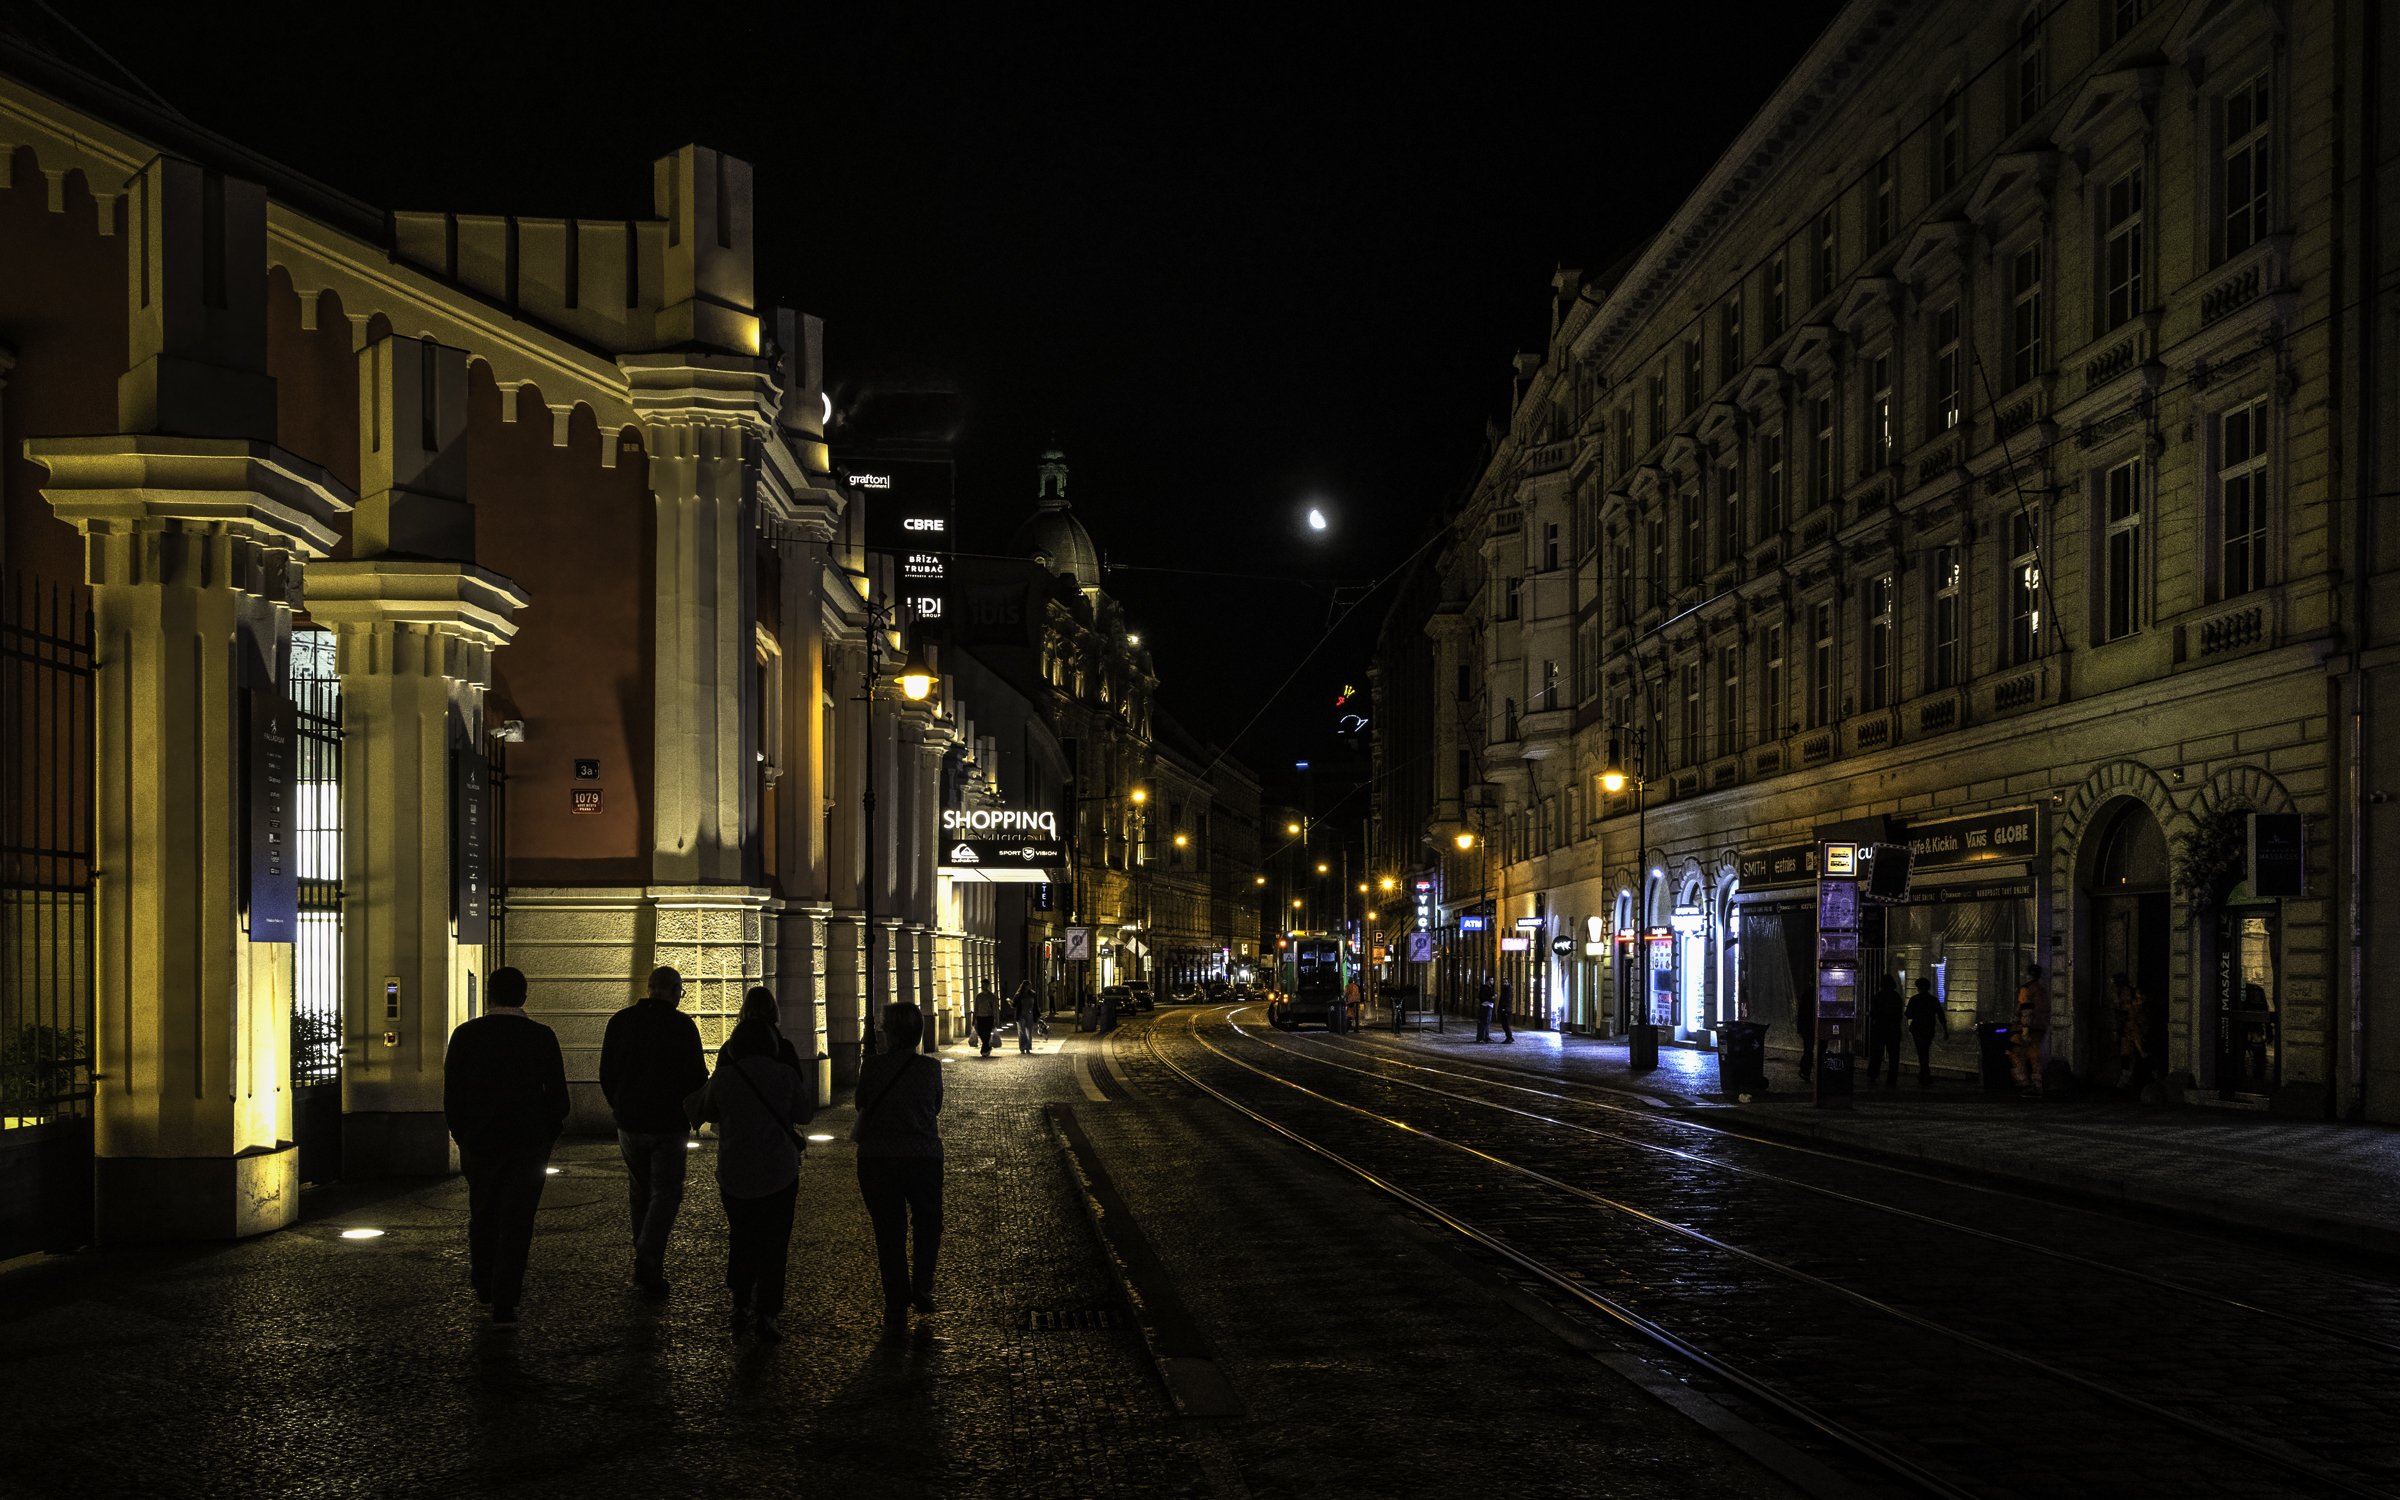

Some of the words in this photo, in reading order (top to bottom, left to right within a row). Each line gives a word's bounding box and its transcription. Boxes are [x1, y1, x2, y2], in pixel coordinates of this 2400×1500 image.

[849, 474, 888, 486] grafton
[904, 518, 944, 531] CBRE
[905, 565, 944, 573] TRUBAČ
[972, 600, 1019, 624] ibis
[580, 765, 593, 776] 3a
[575, 793, 599, 803] 1079
[943, 810, 1056, 841] SHOPPING
[1994, 823, 2029, 845] GLOBE
[1743, 860, 1767, 878] SMITH
[1375, 932, 1383, 942] P
